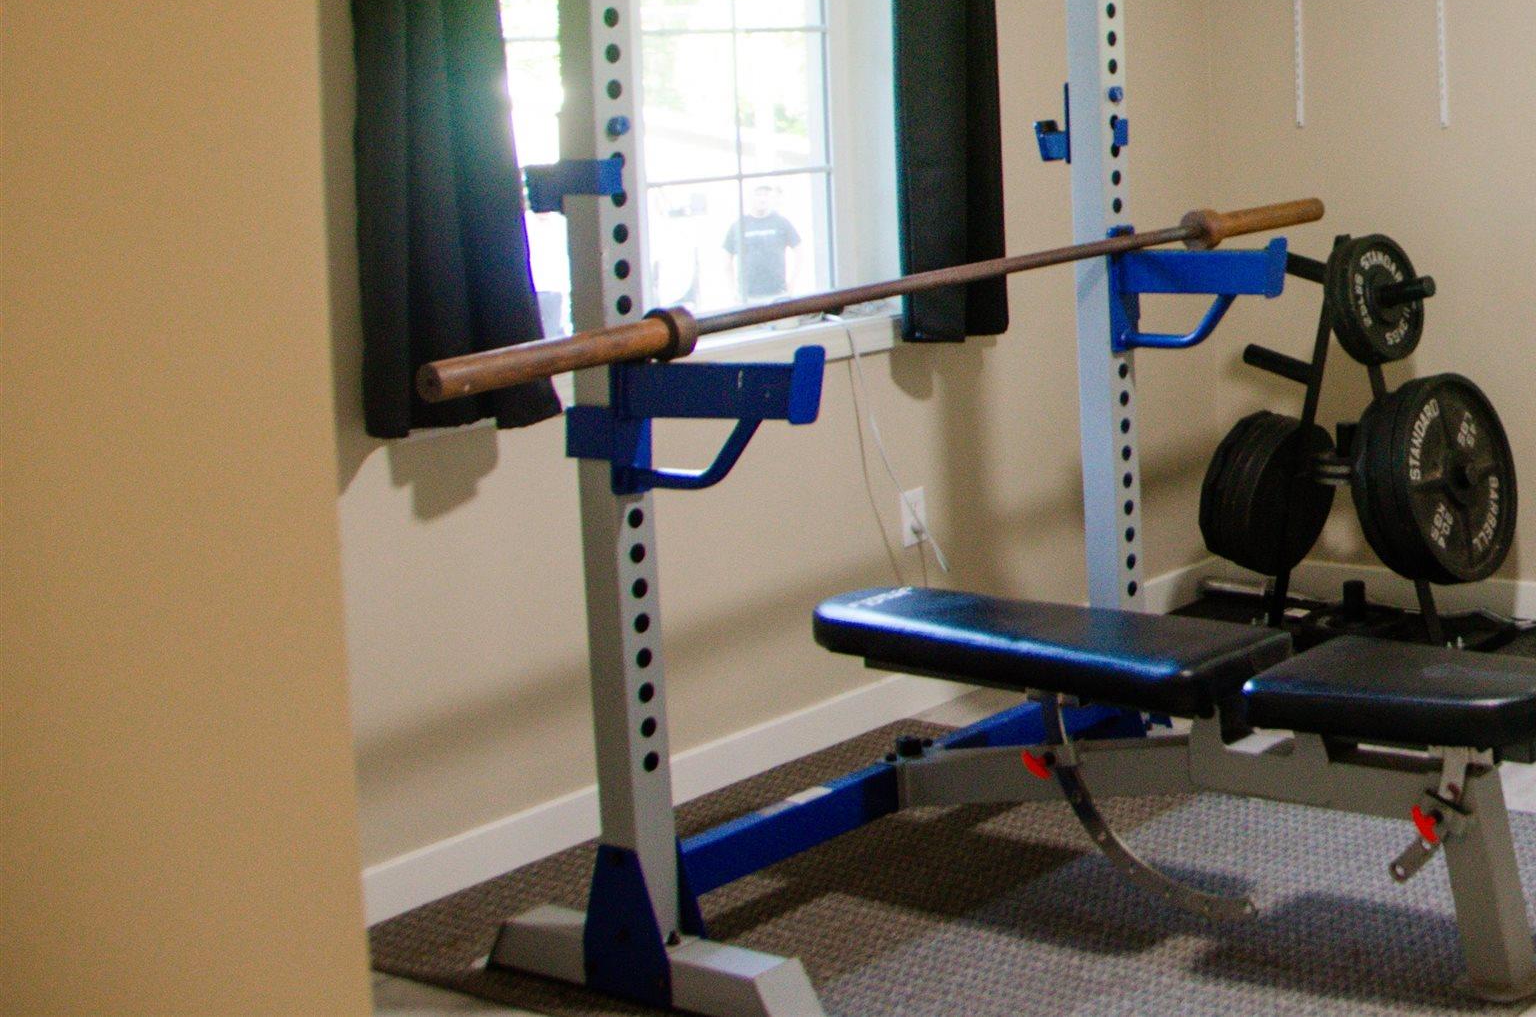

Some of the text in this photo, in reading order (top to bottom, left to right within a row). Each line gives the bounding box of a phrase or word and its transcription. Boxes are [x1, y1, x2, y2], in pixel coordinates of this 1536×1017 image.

[1360, 249, 1403, 282] STANDAR
[1408, 397, 1440, 482] STANDARD
[1430, 501, 1446, 542] KGS
[1472, 474, 1500, 552] BARBELL
